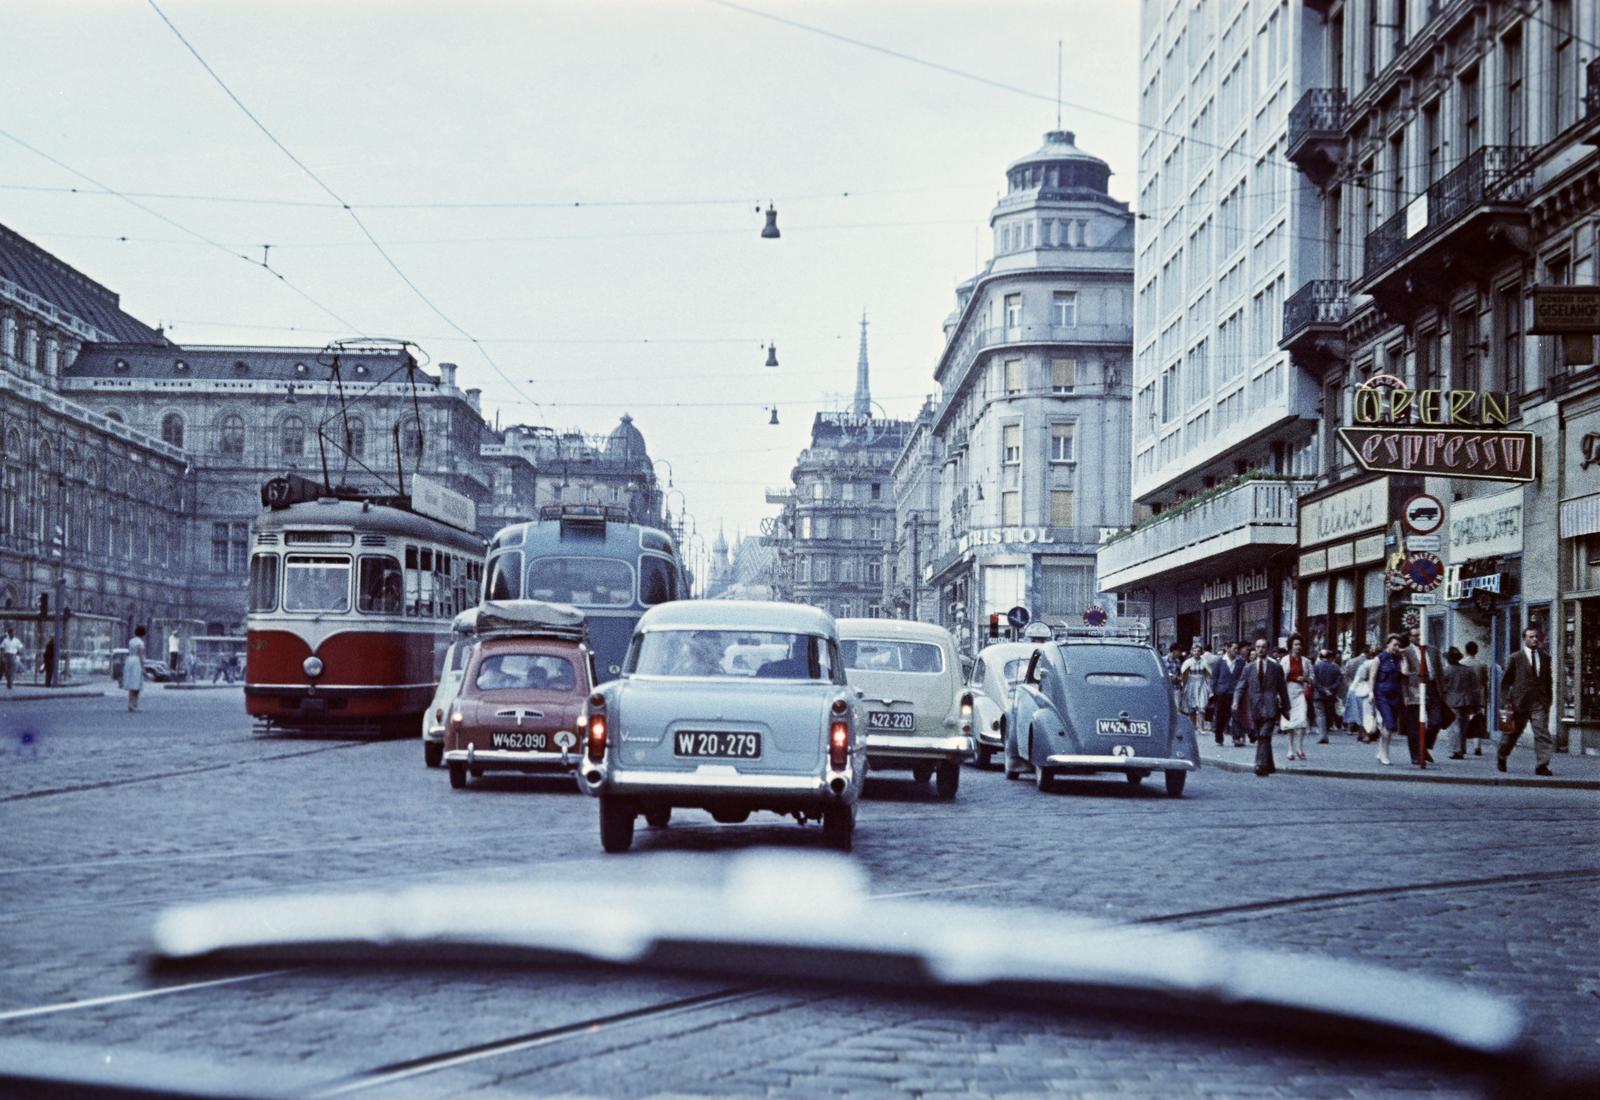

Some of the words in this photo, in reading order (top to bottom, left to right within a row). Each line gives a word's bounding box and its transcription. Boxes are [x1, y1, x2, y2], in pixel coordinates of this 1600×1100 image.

[1354, 388, 1509, 425] OPERN
[1362, 433, 1525, 472] espresso
[268, 482, 289, 500] 67
[1408, 552, 1440, 564] HALTEN
[1200, 580, 1232, 603] Julius
[1236, 567, 1268, 596] Meinl
[1118, 745, 1129, 757] A
